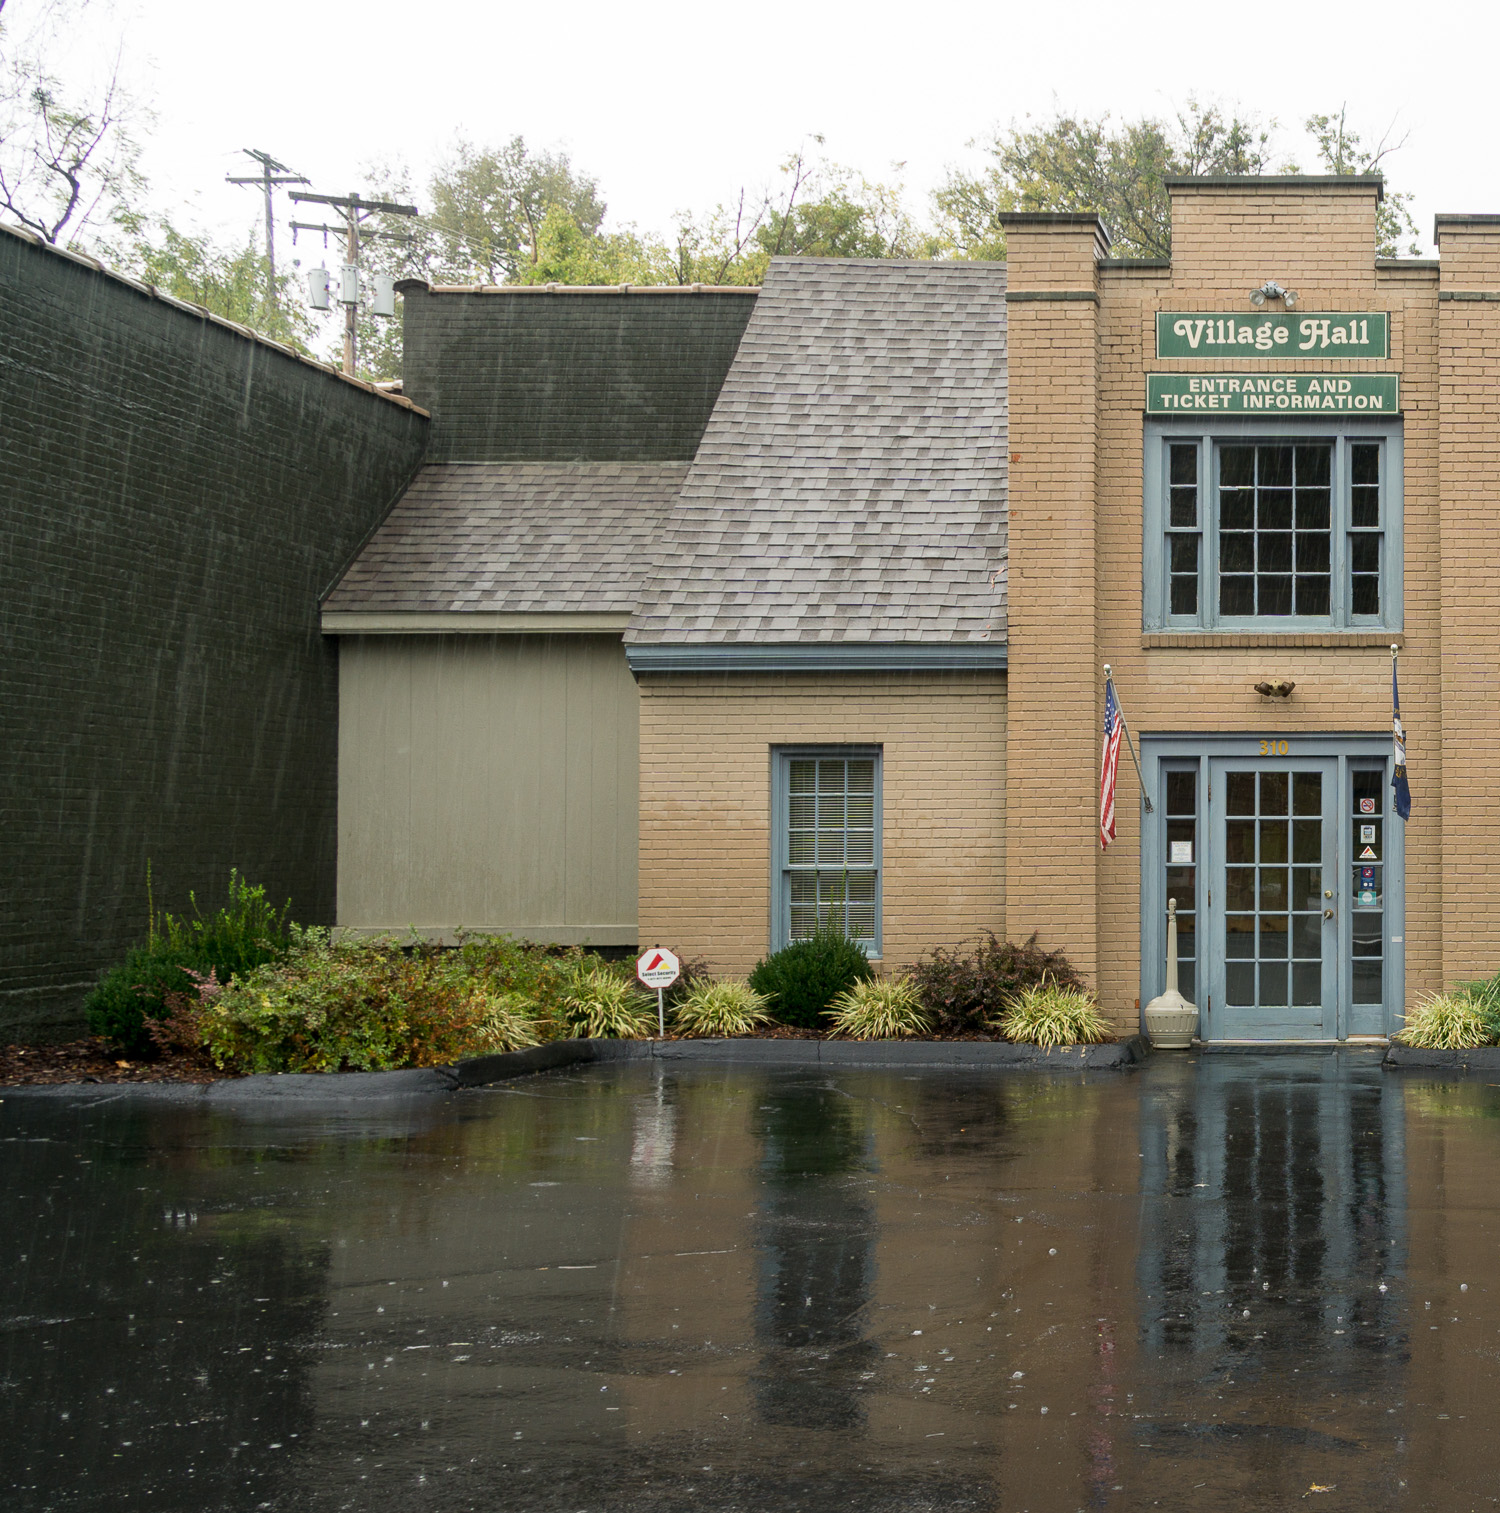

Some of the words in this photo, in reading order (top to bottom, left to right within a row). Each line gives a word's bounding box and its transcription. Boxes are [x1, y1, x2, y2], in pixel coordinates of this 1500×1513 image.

[1173, 319, 1289, 350] Village
[1298, 319, 1370, 350] Hall
[1189, 379, 1297, 393] ENTRANCE
[1307, 379, 1352, 393] AND
[1160, 394, 1232, 409] TICKET
[1243, 394, 1383, 409] INFORMATION
[1259, 740, 1289, 755] 310
